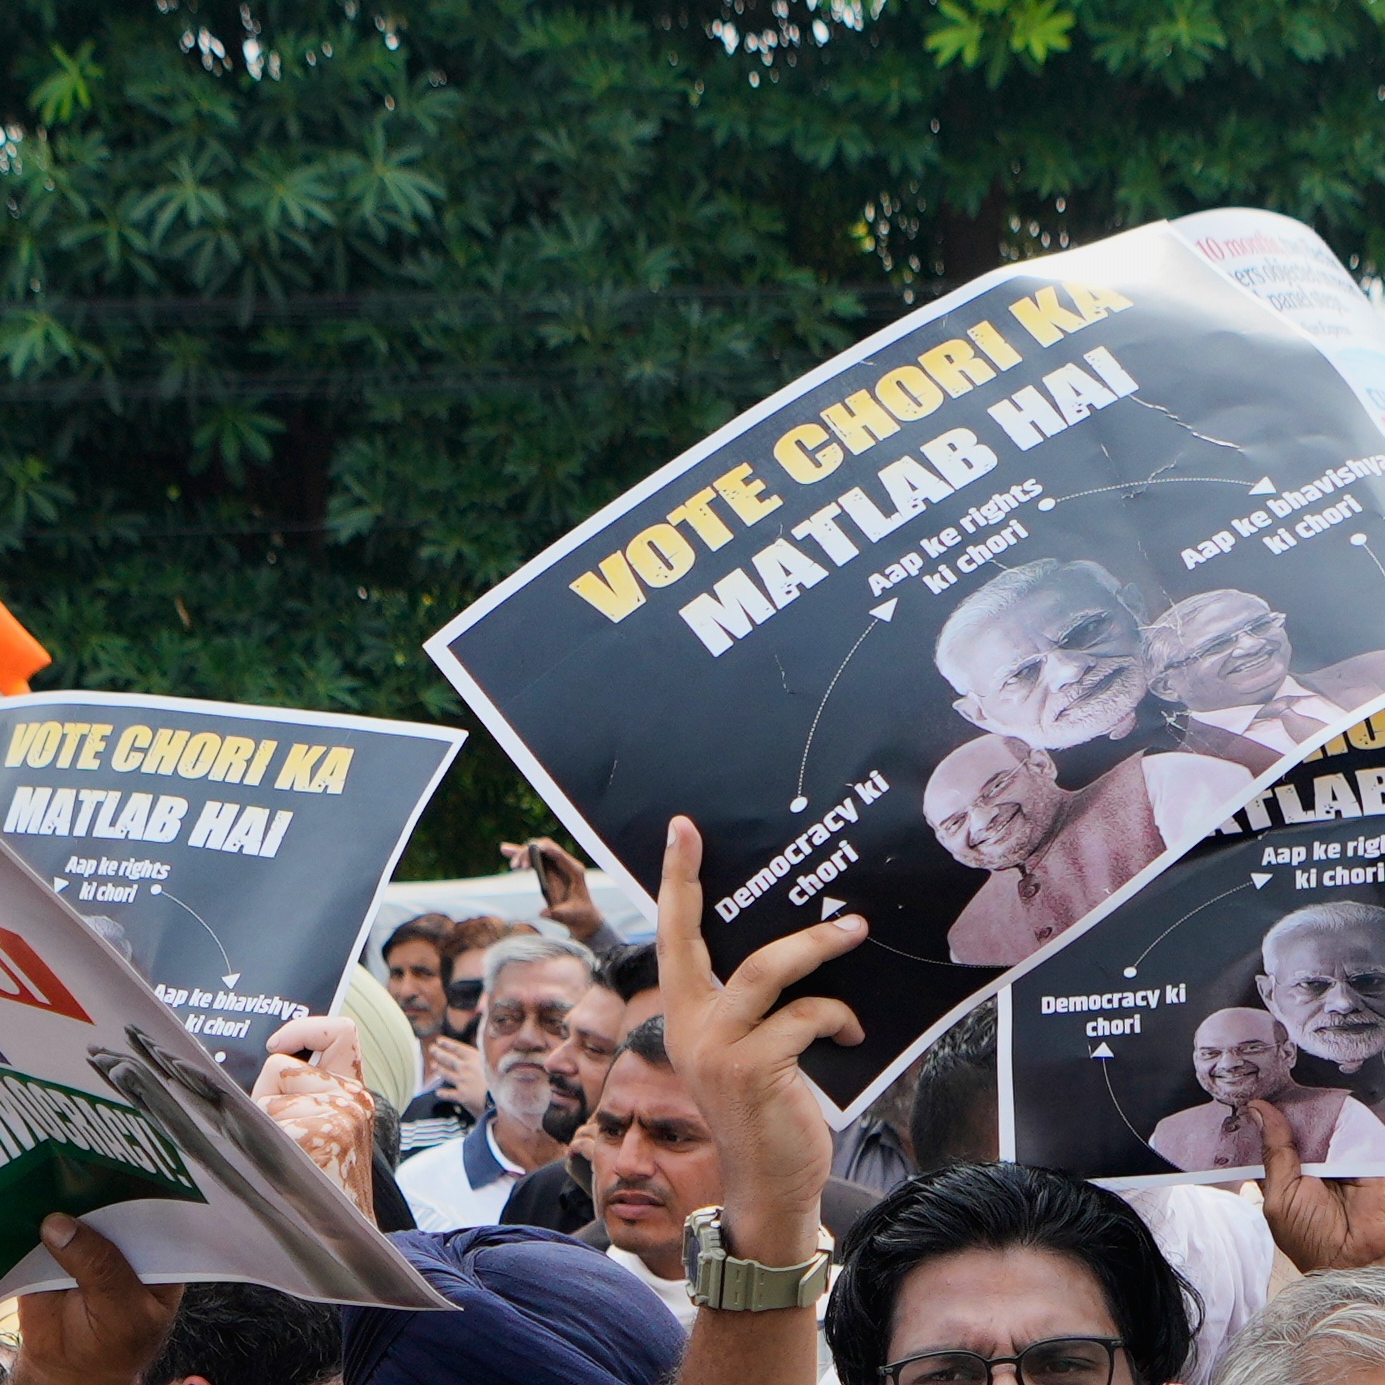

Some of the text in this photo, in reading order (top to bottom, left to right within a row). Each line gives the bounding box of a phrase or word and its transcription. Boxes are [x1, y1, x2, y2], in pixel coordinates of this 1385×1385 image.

[569, 278, 1134, 624] VOTE CHORI KA
[678, 346, 1140, 657] MATLAB HAI
[1263, 494, 1363, 555] ki chori
[868, 478, 1043, 597] Aap ke rights
[922, 519, 1029, 595] ki chori
[1180, 530, 1237, 570] Aap
[1231, 507, 1273, 538] ke
[4, 721, 355, 794] VOTE CHORI KA
[3, 786, 294, 858] MATLAB HAI
[715, 770, 890, 923] Democracy ki
[65, 856, 171, 880] Aap ke rights
[788, 840, 859, 906] chori
[1261, 846, 1306, 866] Aap
[1313, 841, 1341, 860] ke
[1295, 862, 1385, 889] ki chori
[79, 880, 138, 903] ki chori
[154, 984, 310, 1021] Aap ke bhavishya
[185, 1013, 251, 1038] ki chori
[1041, 983, 1187, 1015] Democracy ki
[1085, 1014, 1141, 1037] chori
